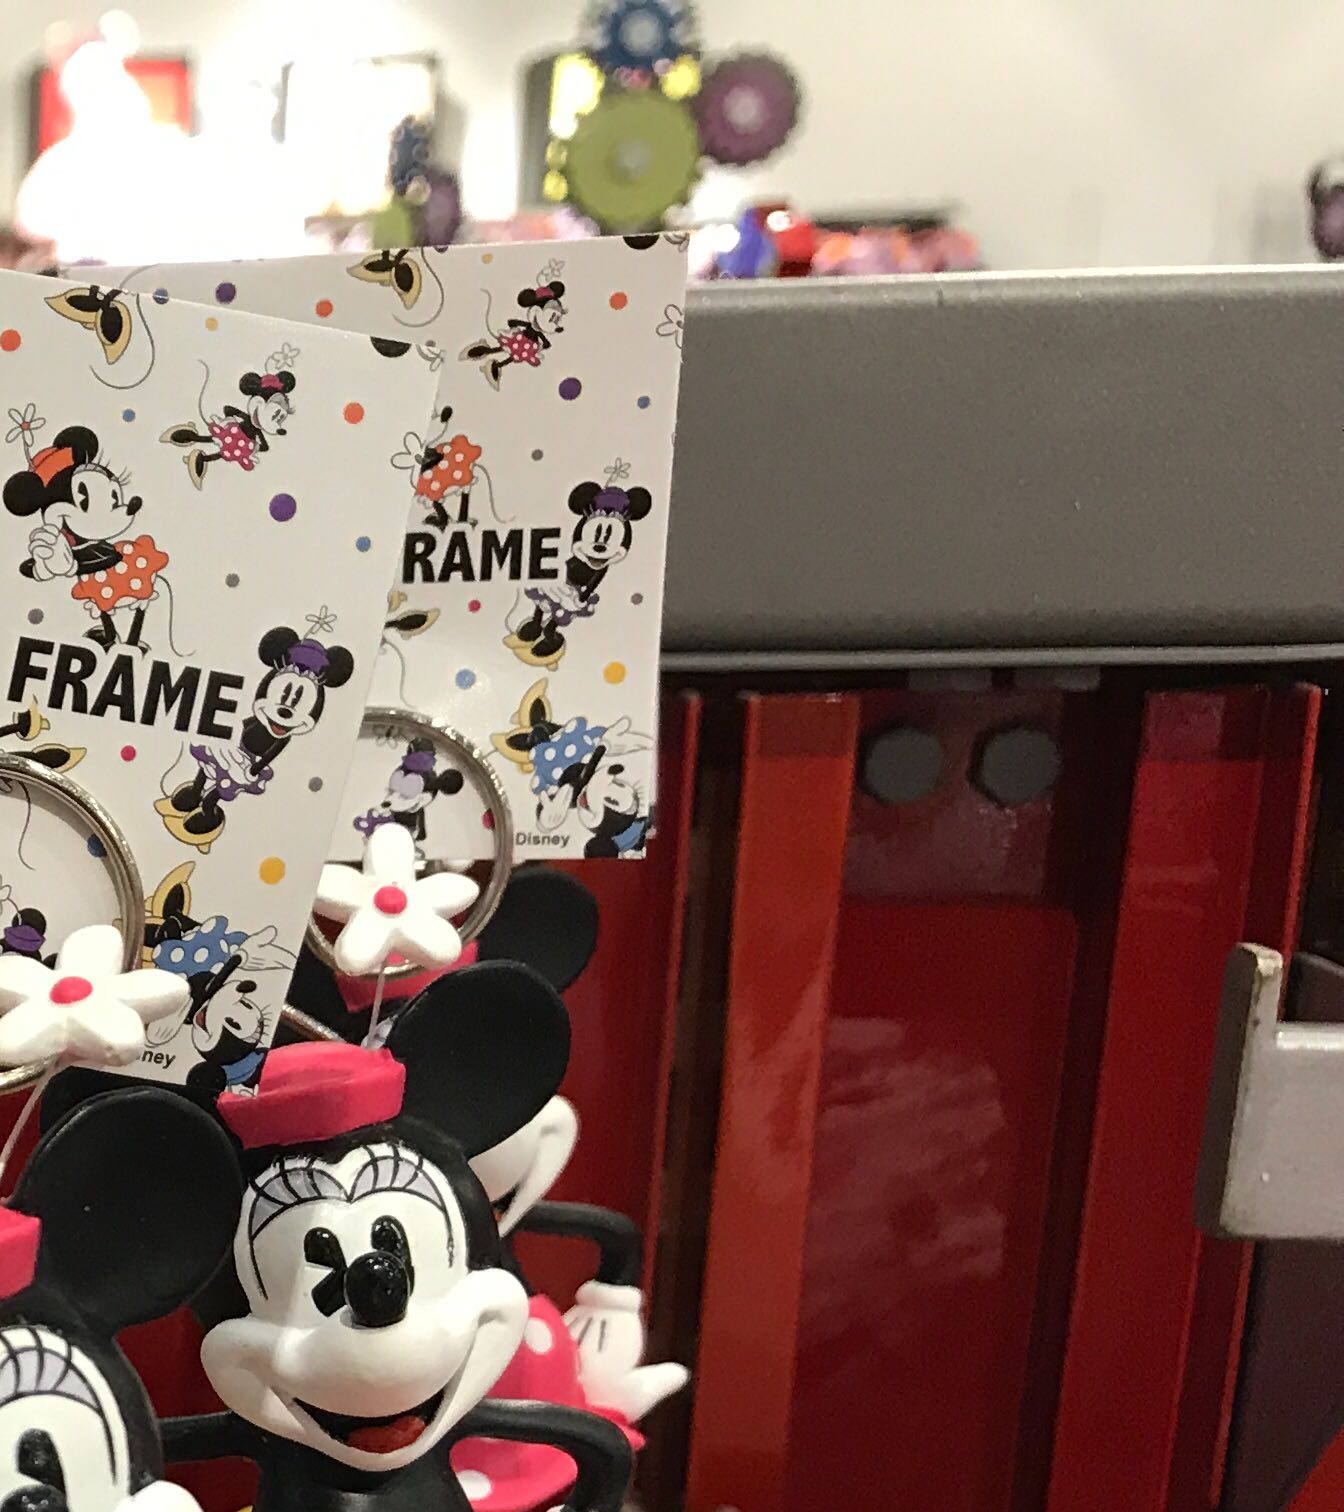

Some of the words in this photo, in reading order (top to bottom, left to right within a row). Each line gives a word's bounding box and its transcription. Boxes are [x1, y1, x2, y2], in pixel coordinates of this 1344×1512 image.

[402, 527, 561, 583] RAME
[7, 637, 245, 740] FRAME
[515, 831, 571, 848] Disney
